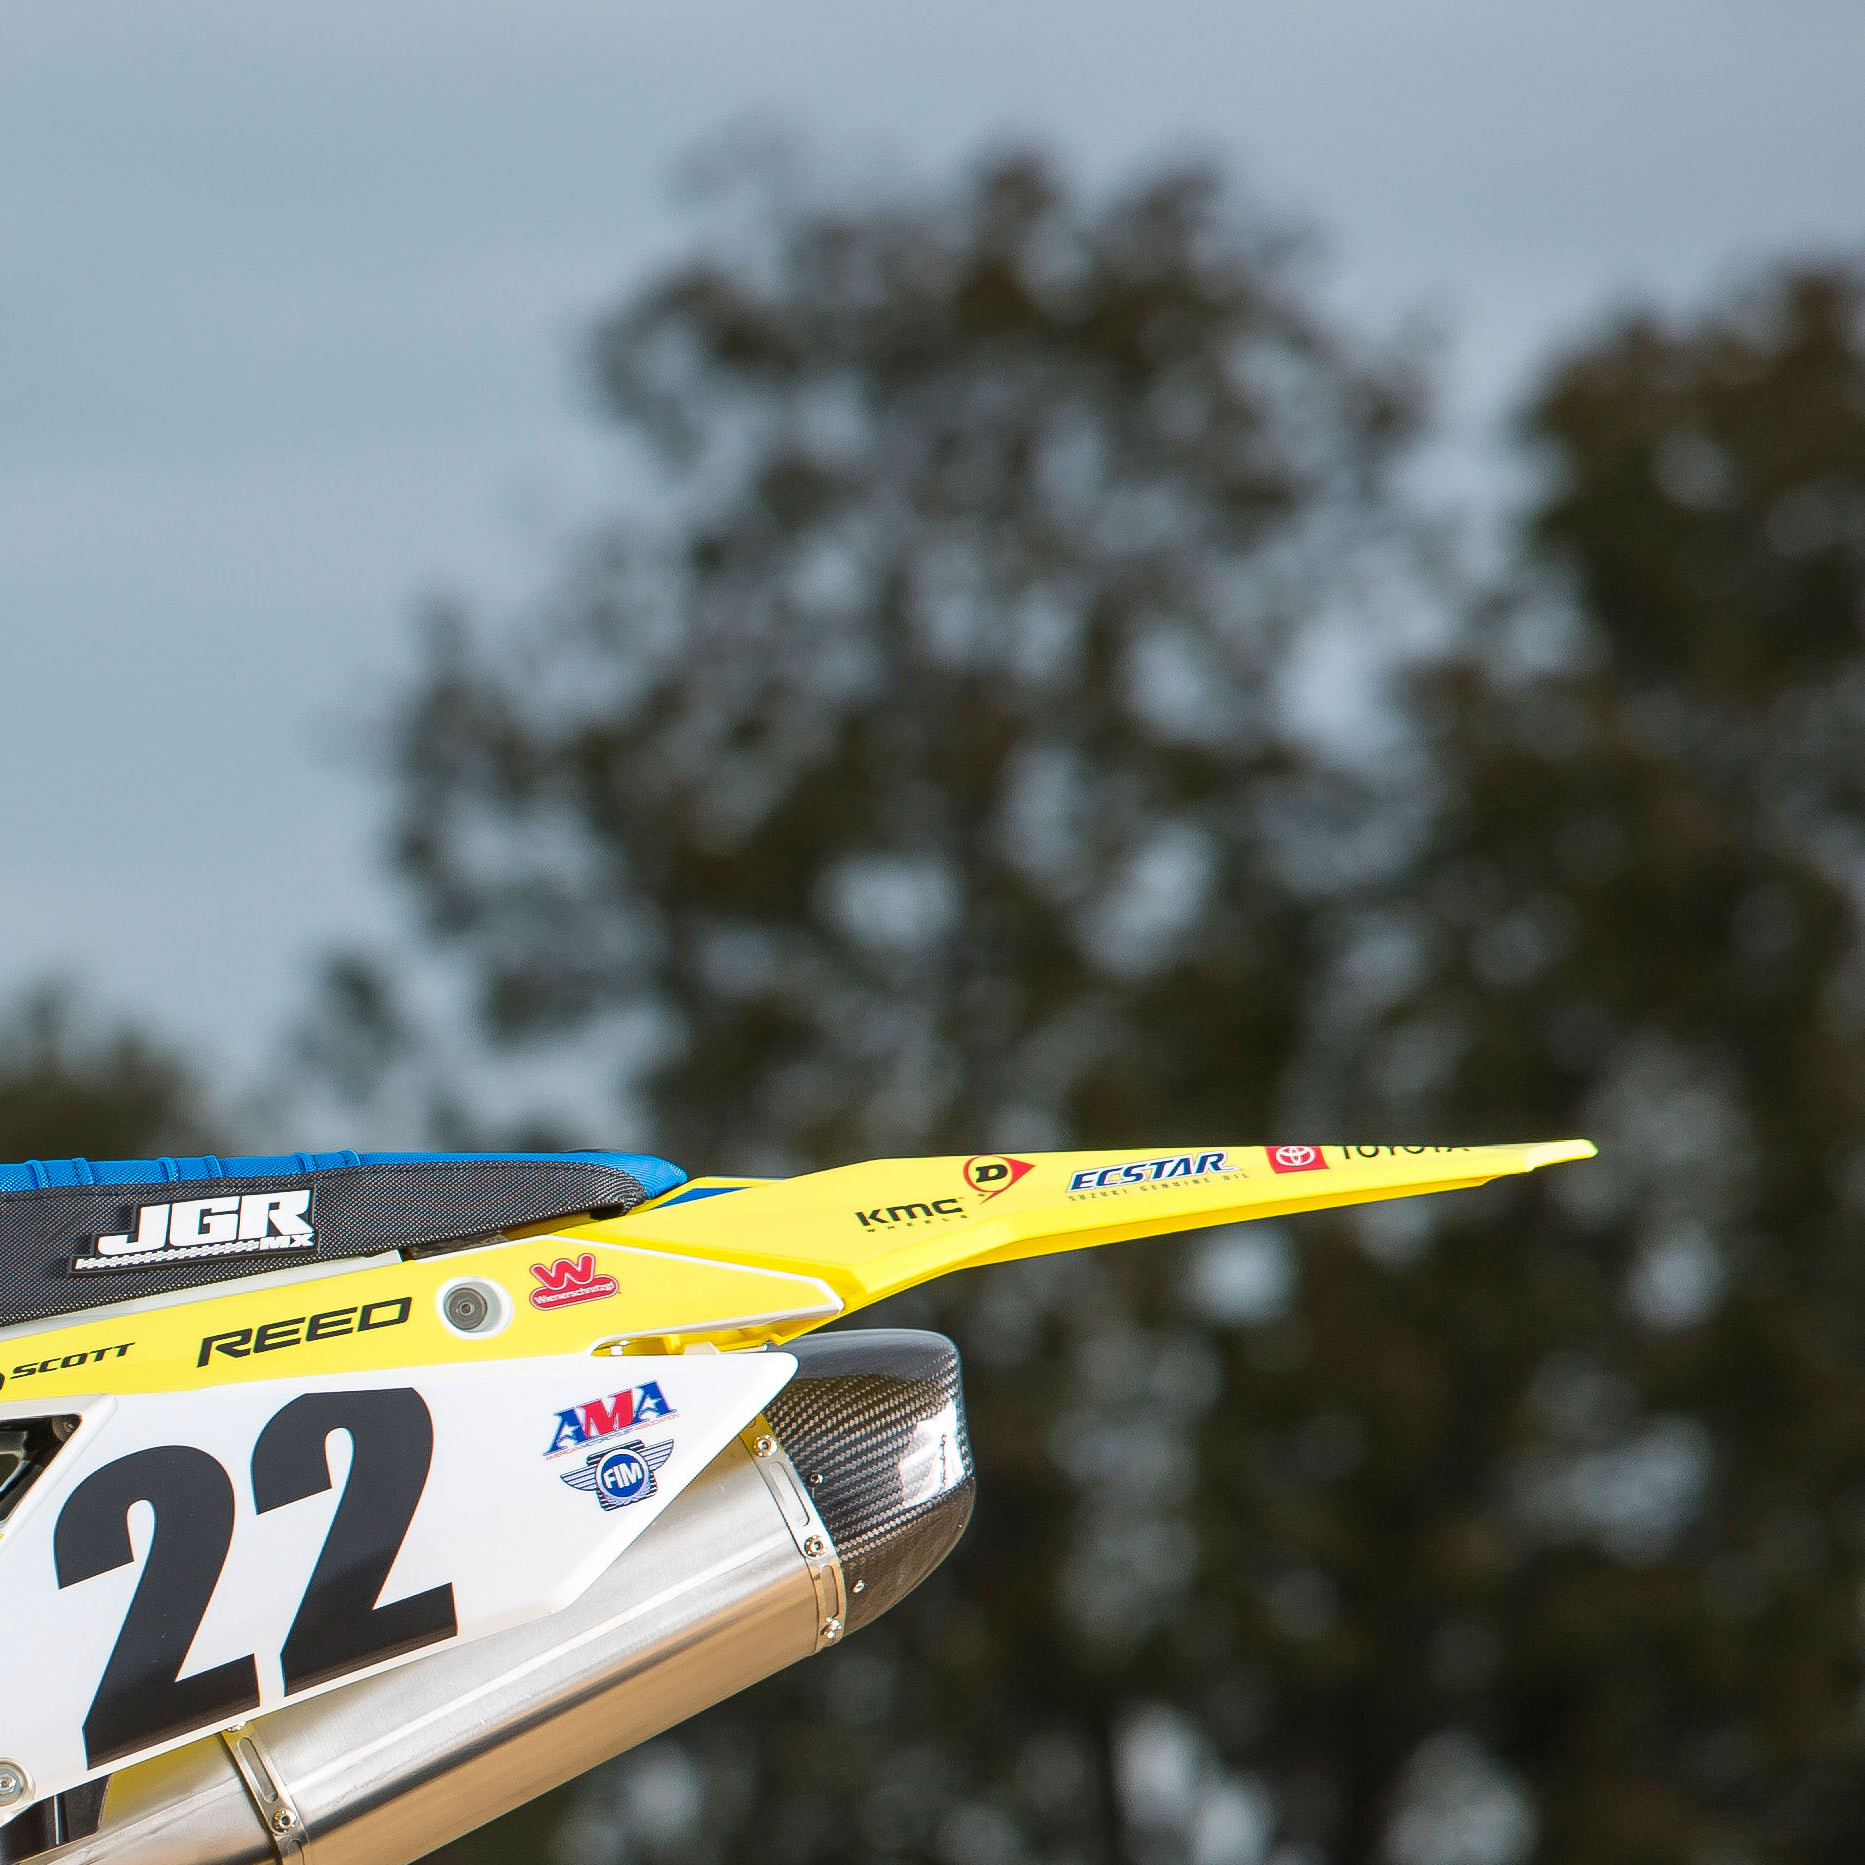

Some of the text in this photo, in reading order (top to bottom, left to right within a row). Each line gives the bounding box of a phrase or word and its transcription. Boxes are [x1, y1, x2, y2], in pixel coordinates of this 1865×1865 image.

[1070, 1152, 1237, 1194] ECSTAR
[97, 1190, 314, 1256] JGR
[855, 1197, 963, 1227] KMC
[259, 1233, 314, 1250] MX
[196, 1296, 412, 1368] REED
[9, 1341, 136, 1381] SCOTT
[542, 1380, 678, 1456] AMA
[603, 1462, 643, 1488] FIM
[55, 1387, 458, 1771] 22
